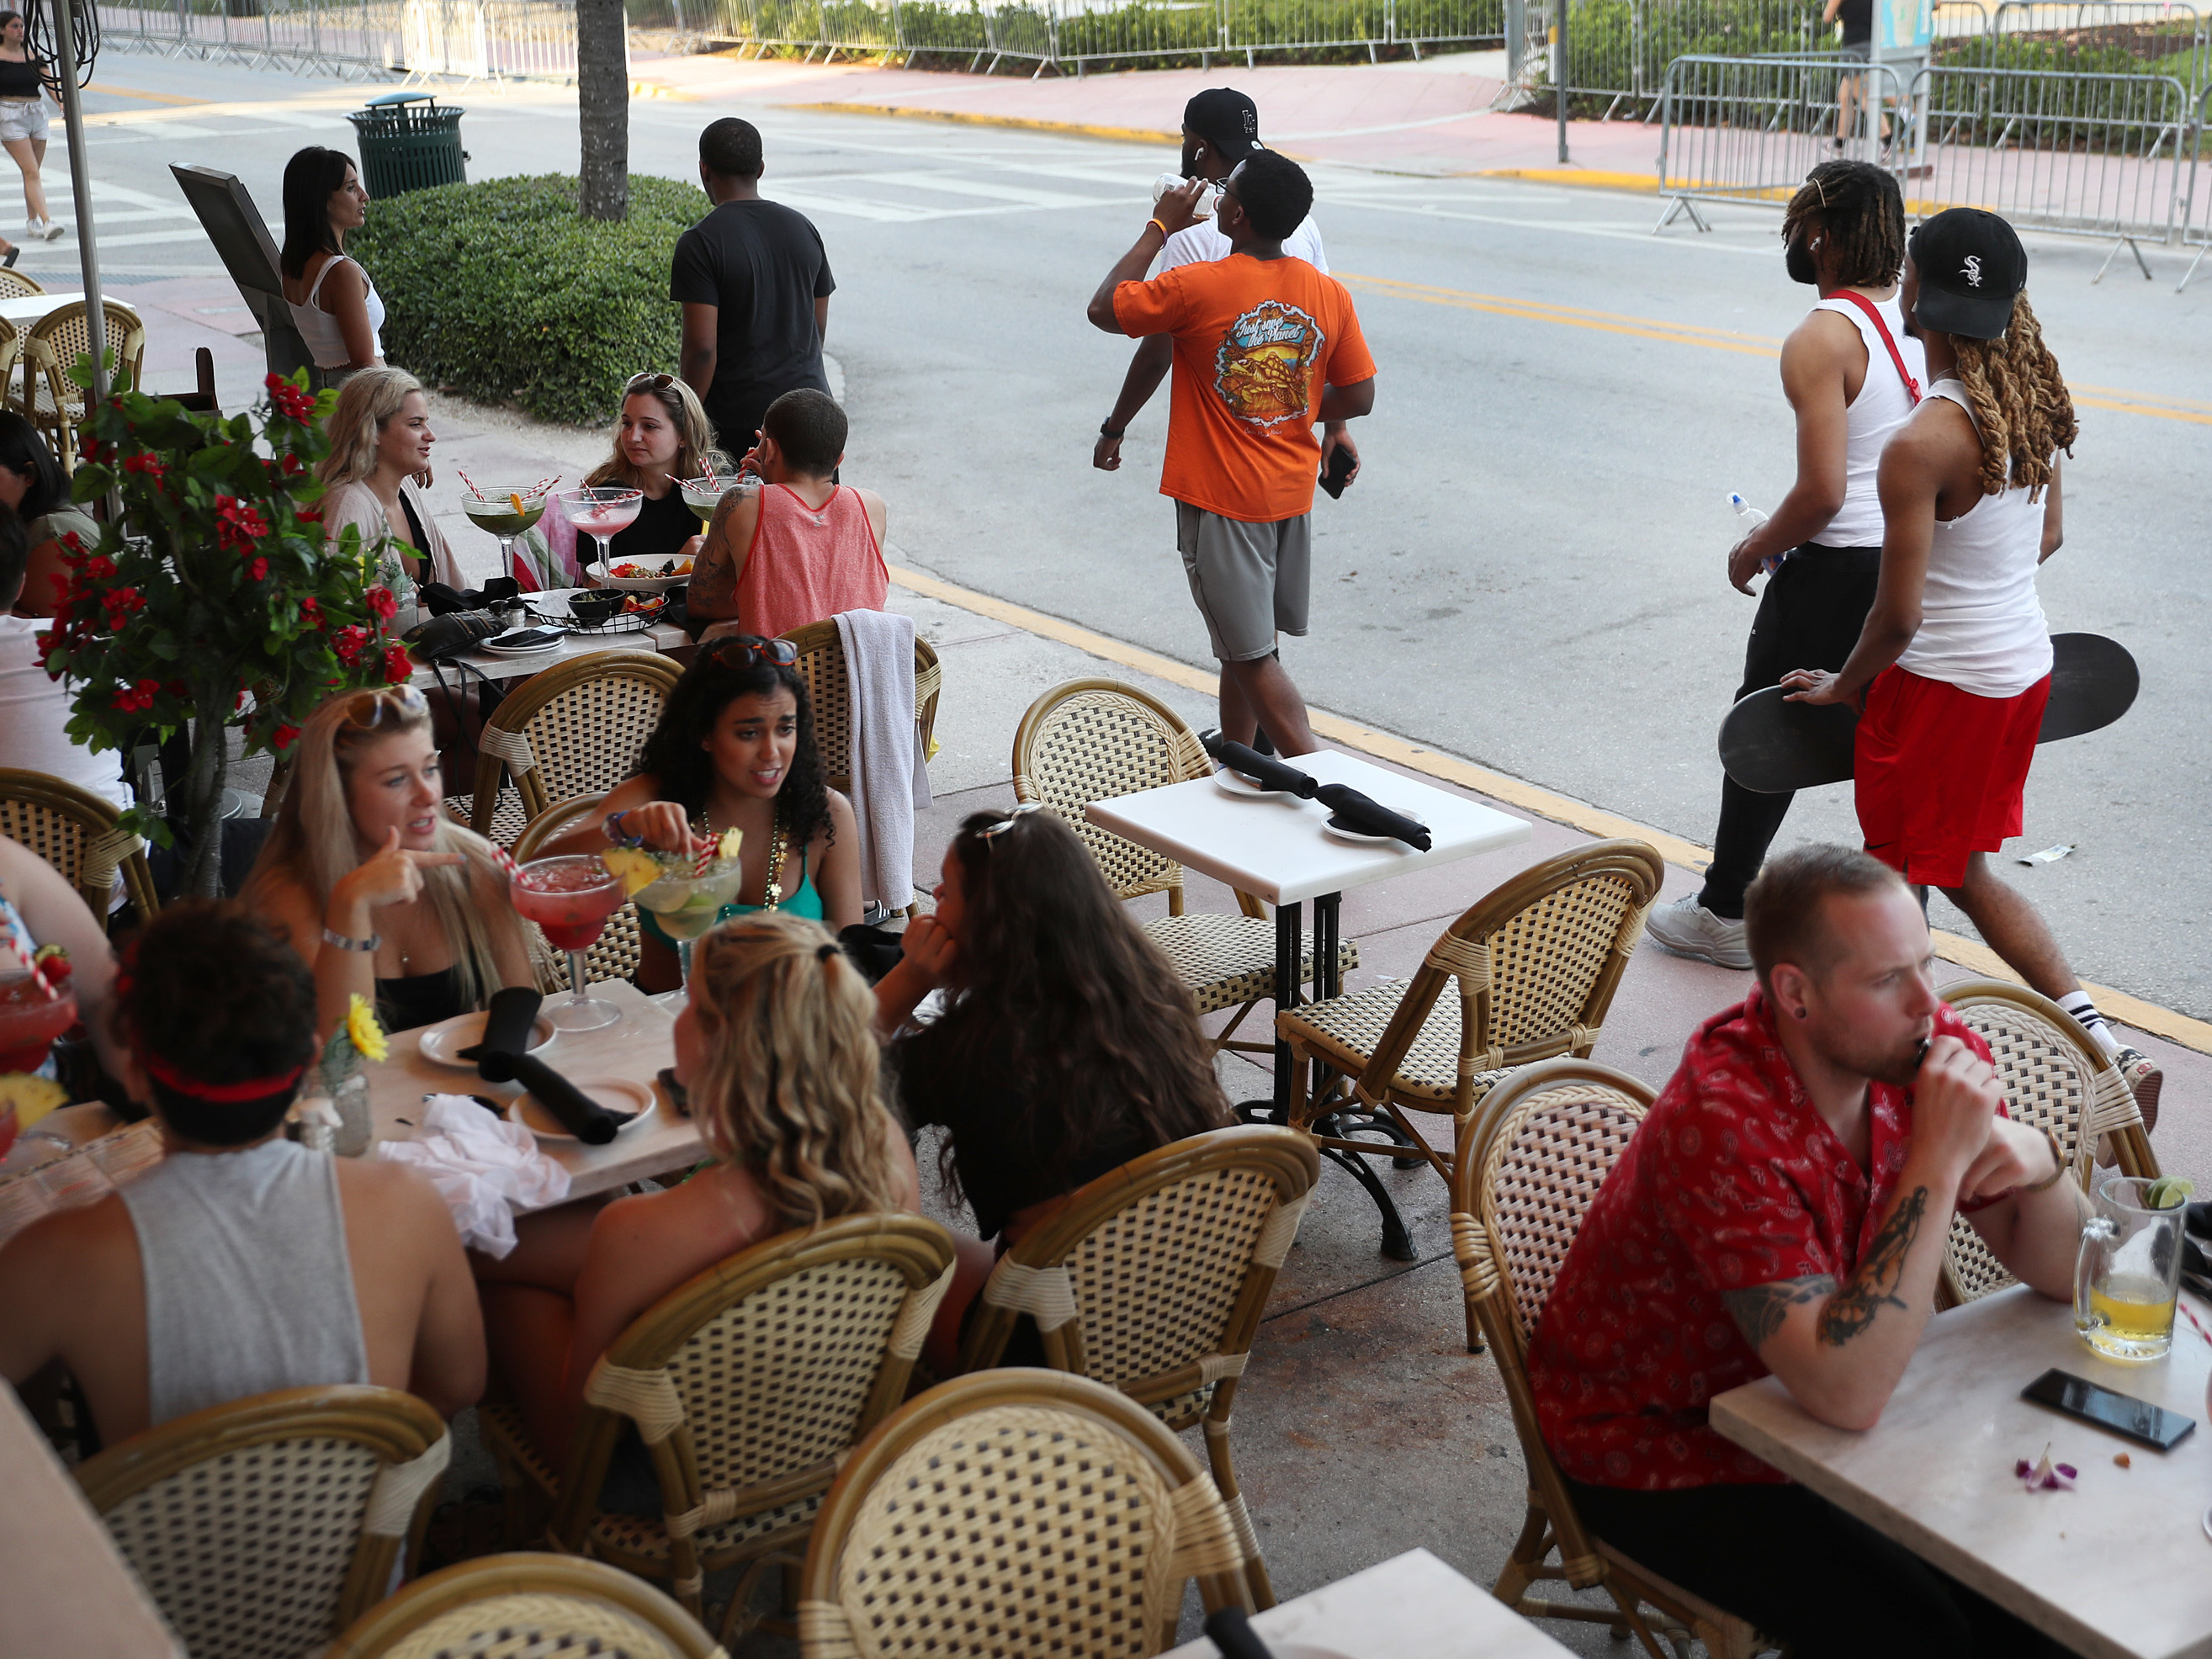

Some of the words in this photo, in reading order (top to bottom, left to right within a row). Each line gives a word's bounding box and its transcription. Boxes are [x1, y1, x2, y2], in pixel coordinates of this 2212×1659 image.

[1236, 317, 1262, 337] Just
[1261, 315, 1284, 331] save
[1247, 331, 1264, 347] the
[1267, 323, 1304, 343] Planet
